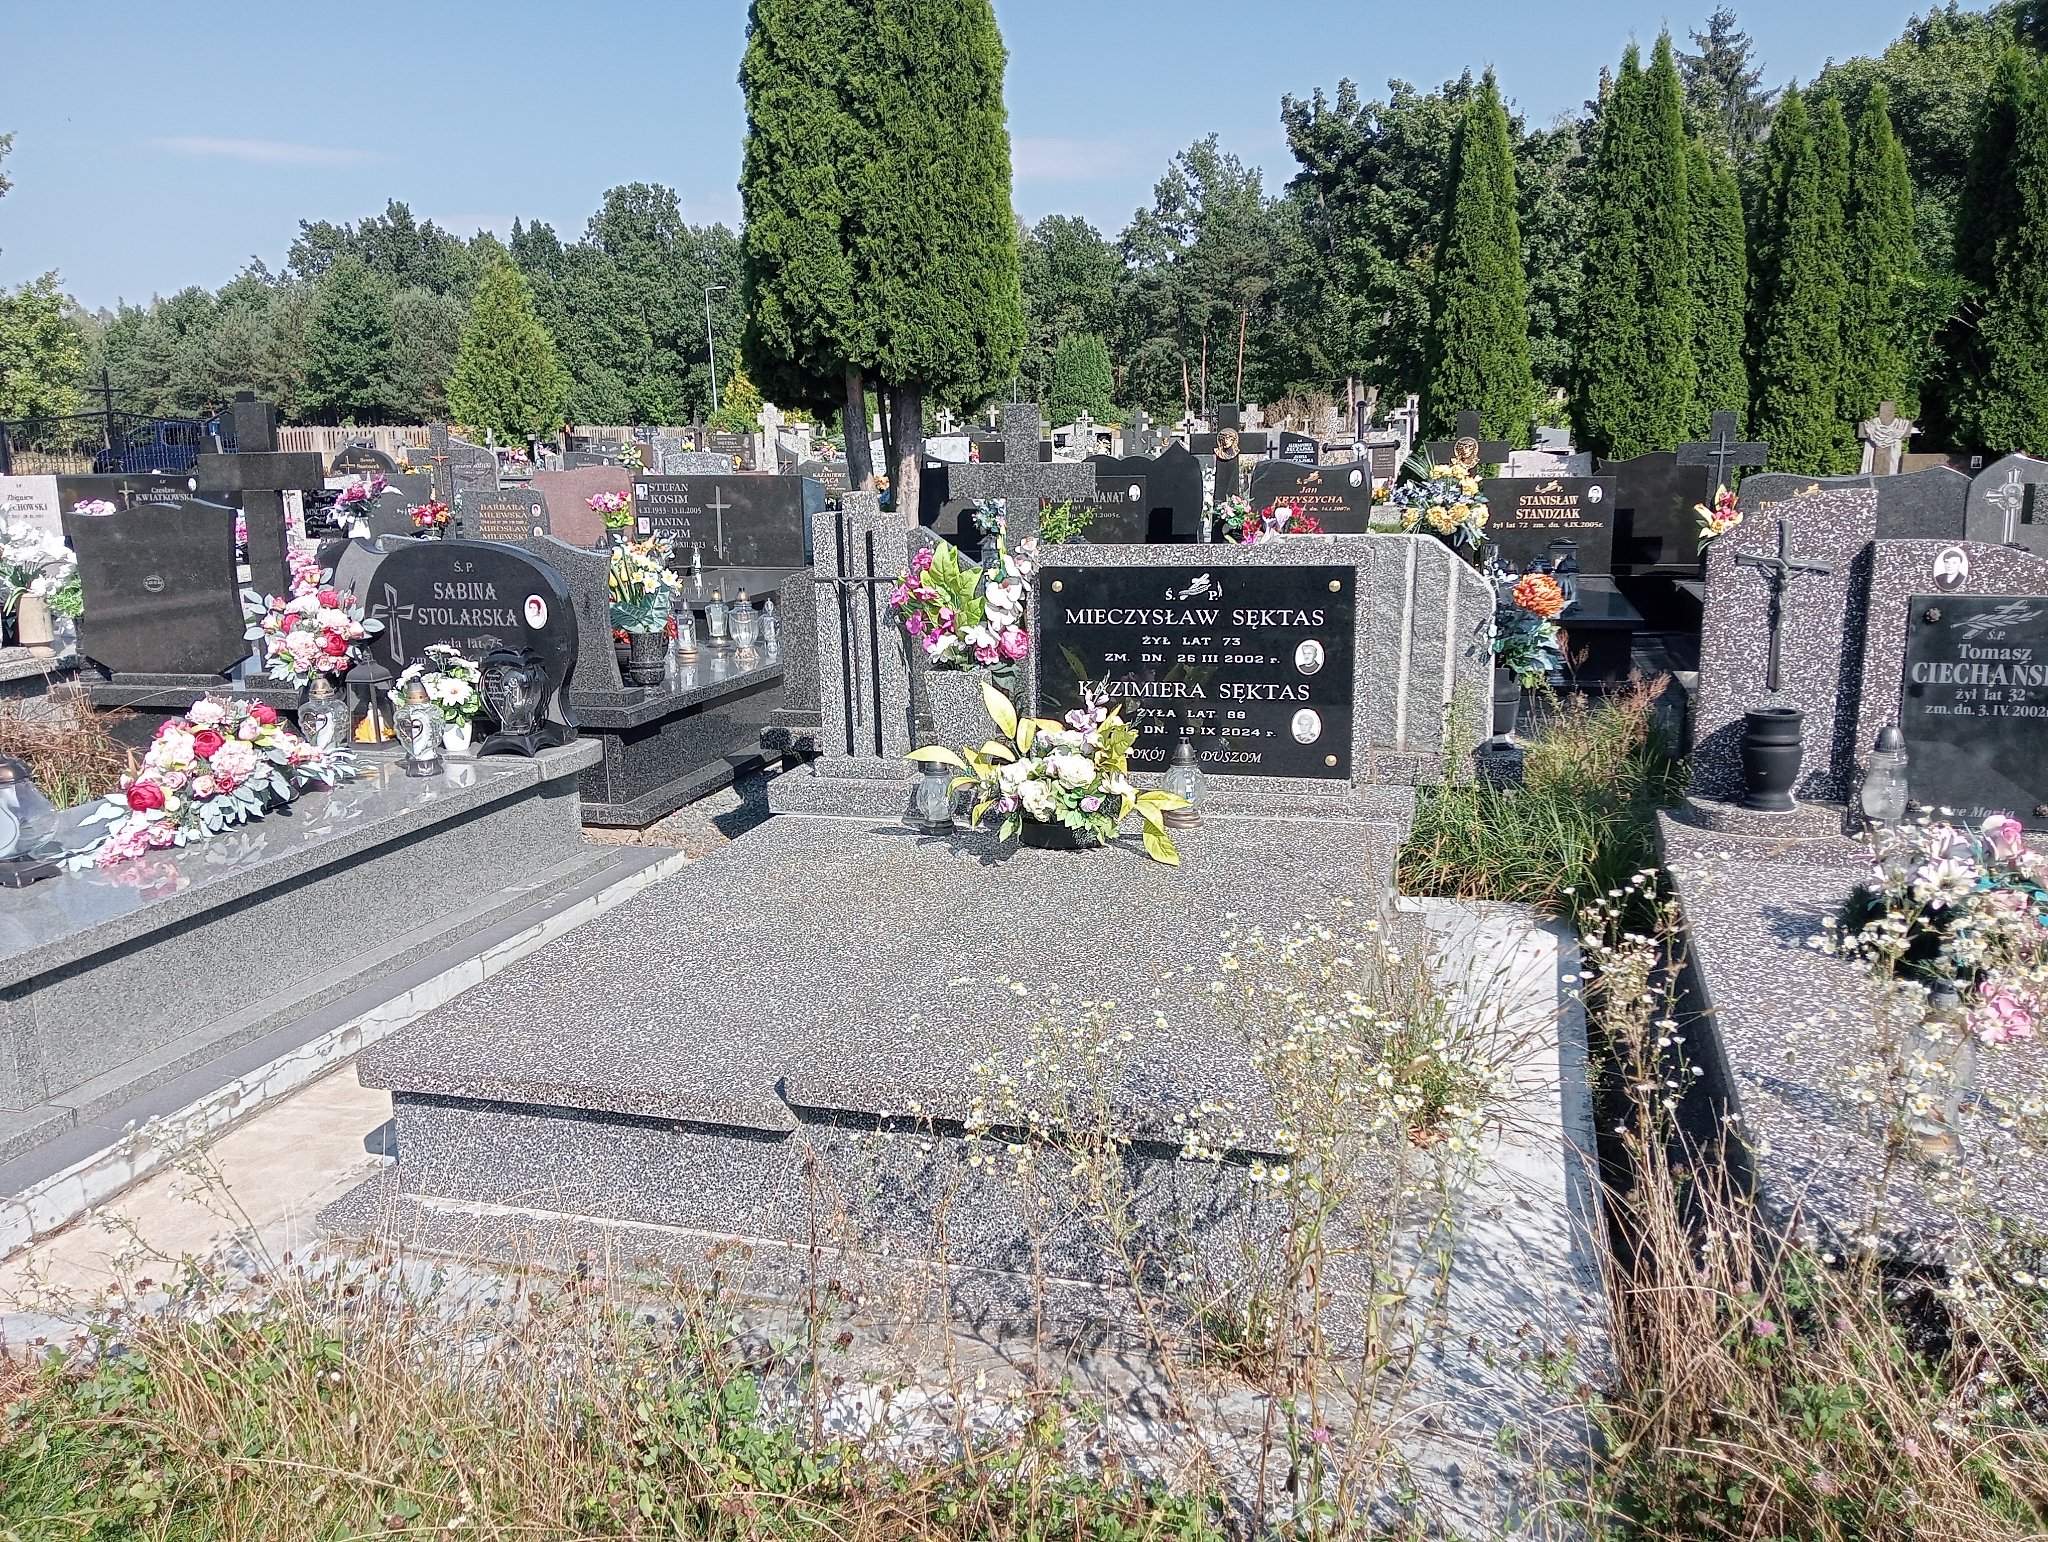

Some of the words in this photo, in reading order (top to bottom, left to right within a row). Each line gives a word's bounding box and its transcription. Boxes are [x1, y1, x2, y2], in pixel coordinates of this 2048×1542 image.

[648, 483, 689, 492] STEFAN
[1299, 486, 1318, 494] Jan
[135, 493, 194, 502] KWIATKOWSKI
[650, 494, 689, 504] KOSIM
[1274, 495, 1344, 504] KRZYSZYCHA
[1519, 495, 1580, 506] STANISŁAW
[480, 503, 526, 511] BARBARA
[479, 512, 528, 520] MILEWSKA
[1515, 508, 1581, 519] STANDZIAK
[651, 517, 691, 526] JANINA
[453, 560, 464, 573] Ś.
[465, 562, 475, 573] P.
[433, 582, 498, 601] SABINA
[1165, 587, 1176, 601] Ś.
[1208, 590, 1219, 601] P.
[417, 608, 520, 628] STOLARSKA
[1065, 608, 1220, 626] MIECZYSŁAW
[1232, 609, 1325, 630] SĘKTAS
[487, 638, 503, 650] 75
[1142, 635, 1172, 646] ŻYŁ
[1182, 637, 1212, 646] LAT
[1222, 637, 1242, 647] 73
[1957, 643, 2033, 661] Tomasz
[1104, 653, 1131, 663] ZM.
[1141, 653, 1167, 663] DN.
[1177, 654, 1196, 664] 26
[1201, 654, 1219, 664] III
[1224, 655, 1264, 664] 2002
[1078, 680, 1207, 699] KAZIMIERA
[1219, 683, 1310, 703] SĘKTAS
[1955, 688, 1977, 703] żył
[1984, 688, 2001, 701] lat
[2008, 688, 2026, 703] 32
[1136, 707, 1177, 718] ŻYŁA
[1187, 709, 1216, 719] LAT
[1924, 704, 1951, 715] zm.
[1954, 704, 1976, 716] dn.
[1977, 705, 1990, 717] 3.
[1993, 705, 2009, 717] IV.
[1144, 725, 1169, 735] DN.
[1179, 727, 1195, 735] 19
[1200, 727, 1216, 736] IX
[1221, 728, 1261, 737] 2024
[1200, 750, 1262, 764] DUSZOM
